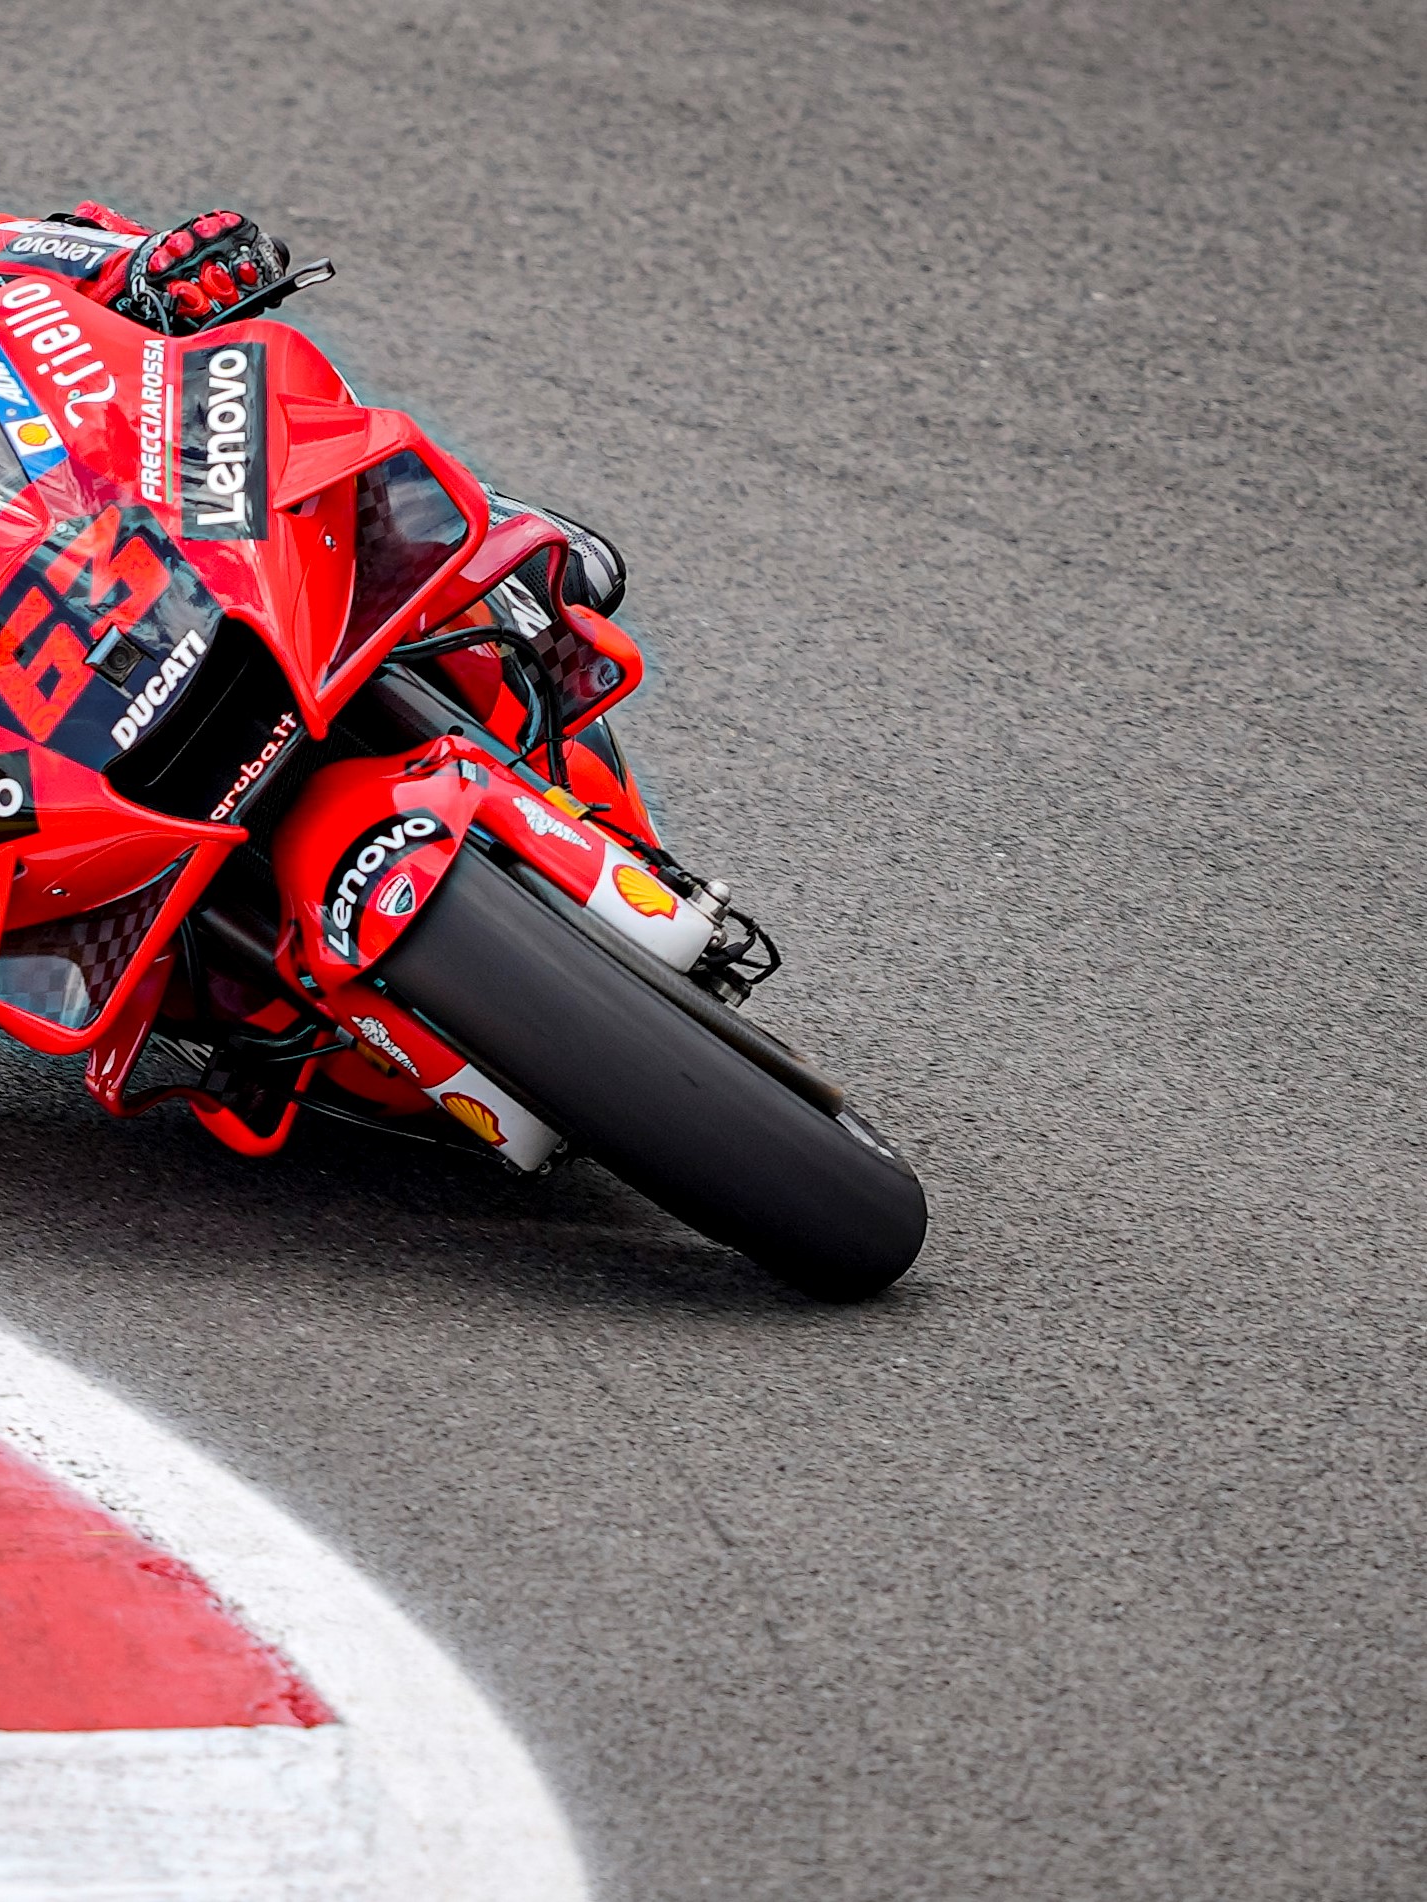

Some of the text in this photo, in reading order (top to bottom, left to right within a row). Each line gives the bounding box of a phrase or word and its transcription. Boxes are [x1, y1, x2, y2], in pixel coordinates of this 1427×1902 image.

[13, 236, 107, 270] Lenovo
[140, 338, 166, 502] FRECCIAROSSA
[197, 348, 248, 527] Lenovo
[111, 629, 208, 751] DUCATI
[209, 712, 299, 822] aruba.it
[327, 817, 437, 957] Lenovo
